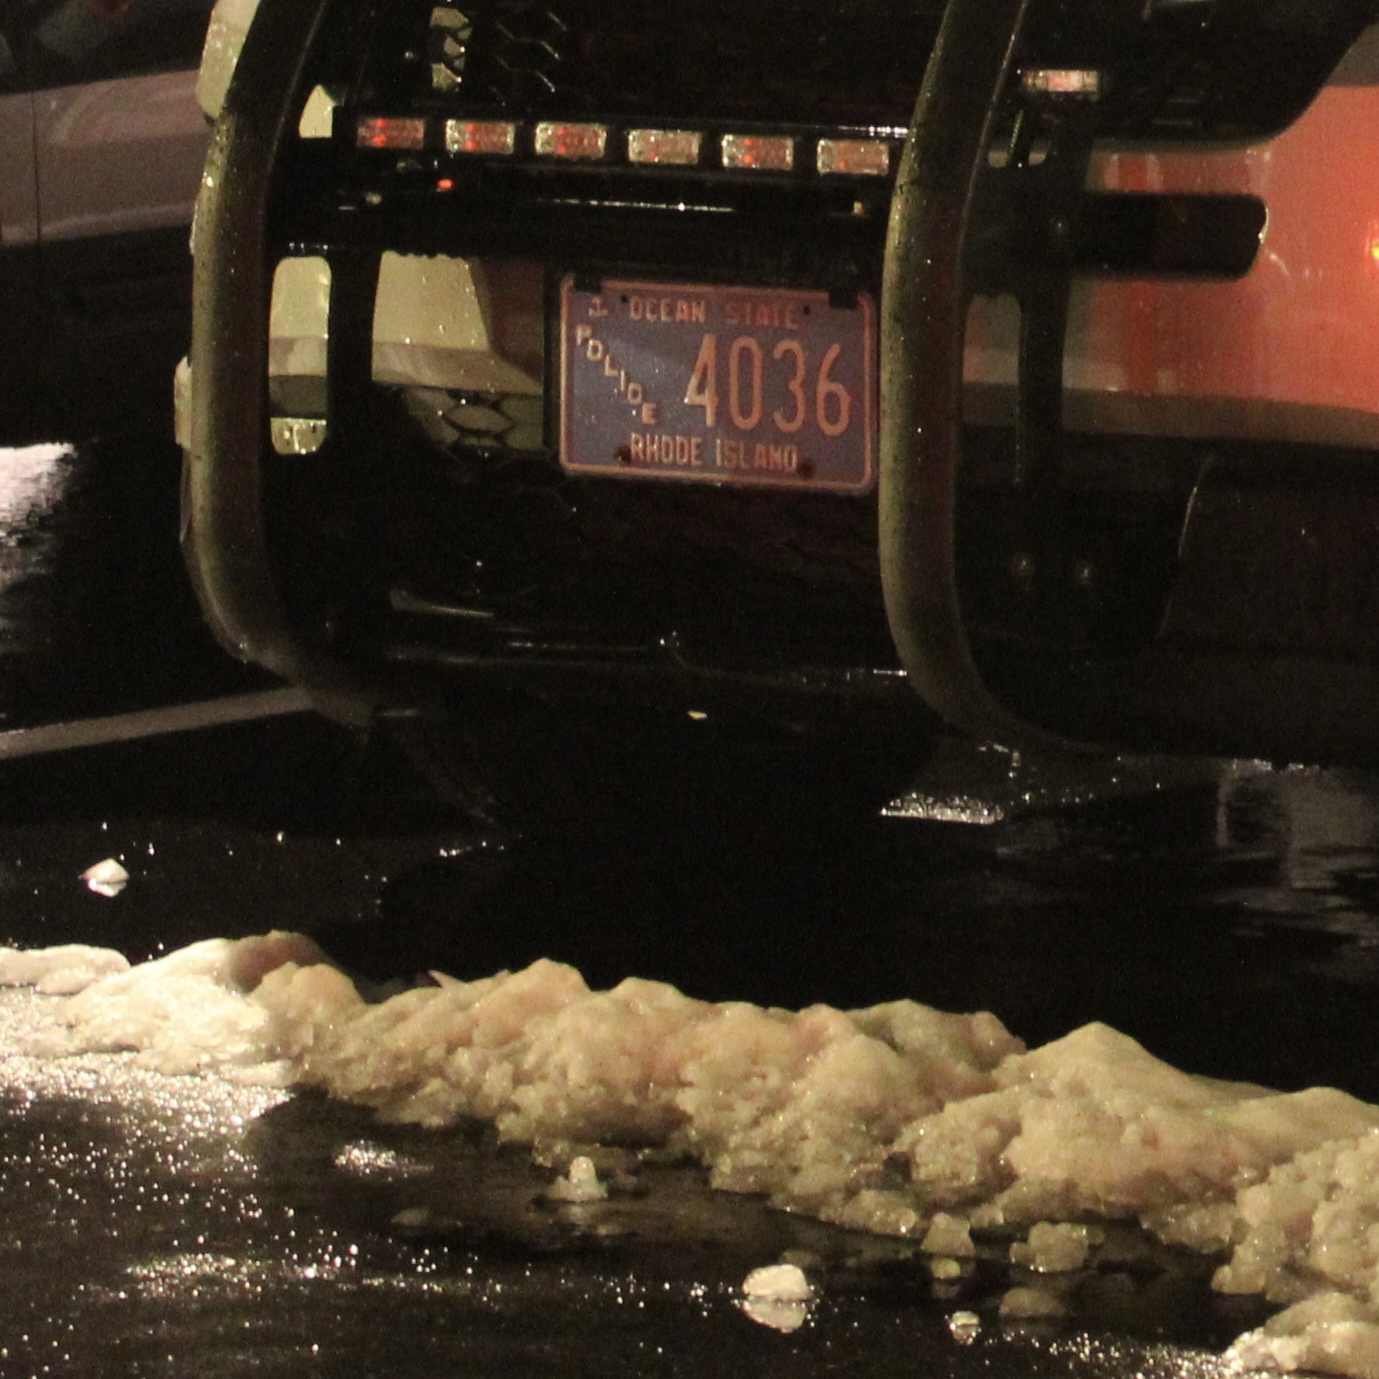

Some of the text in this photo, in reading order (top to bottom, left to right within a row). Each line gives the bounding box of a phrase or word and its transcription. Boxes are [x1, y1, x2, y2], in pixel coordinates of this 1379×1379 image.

[629, 295, 706, 324] OCEAN
[683, 332, 852, 437] 4036
[630, 432, 799, 470] RHODE ISLAND
